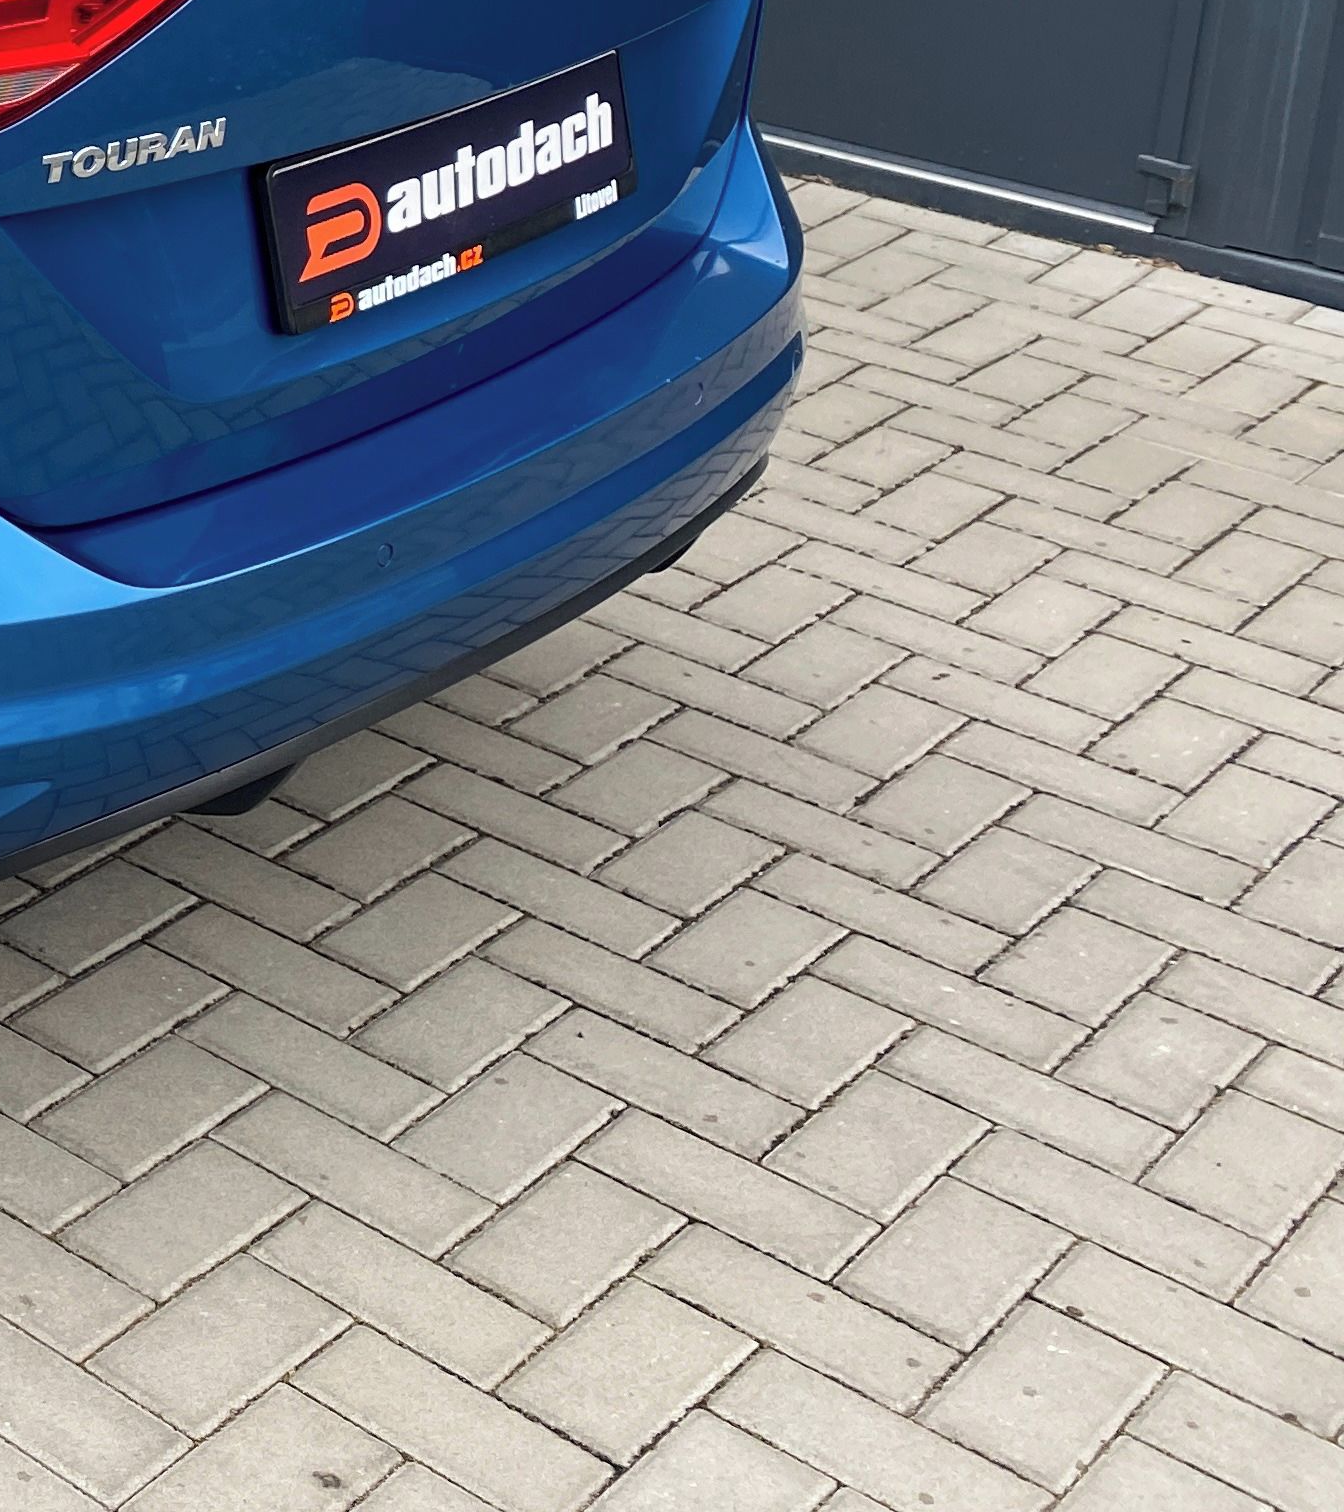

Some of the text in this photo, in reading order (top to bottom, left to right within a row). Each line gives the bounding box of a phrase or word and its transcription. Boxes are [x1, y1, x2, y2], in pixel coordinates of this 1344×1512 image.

[42, 117, 227, 184] TOURAN
[386, 92, 613, 233] autodach
[575, 178, 618, 219] Litovel
[358, 244, 484, 311] autodach.cz
